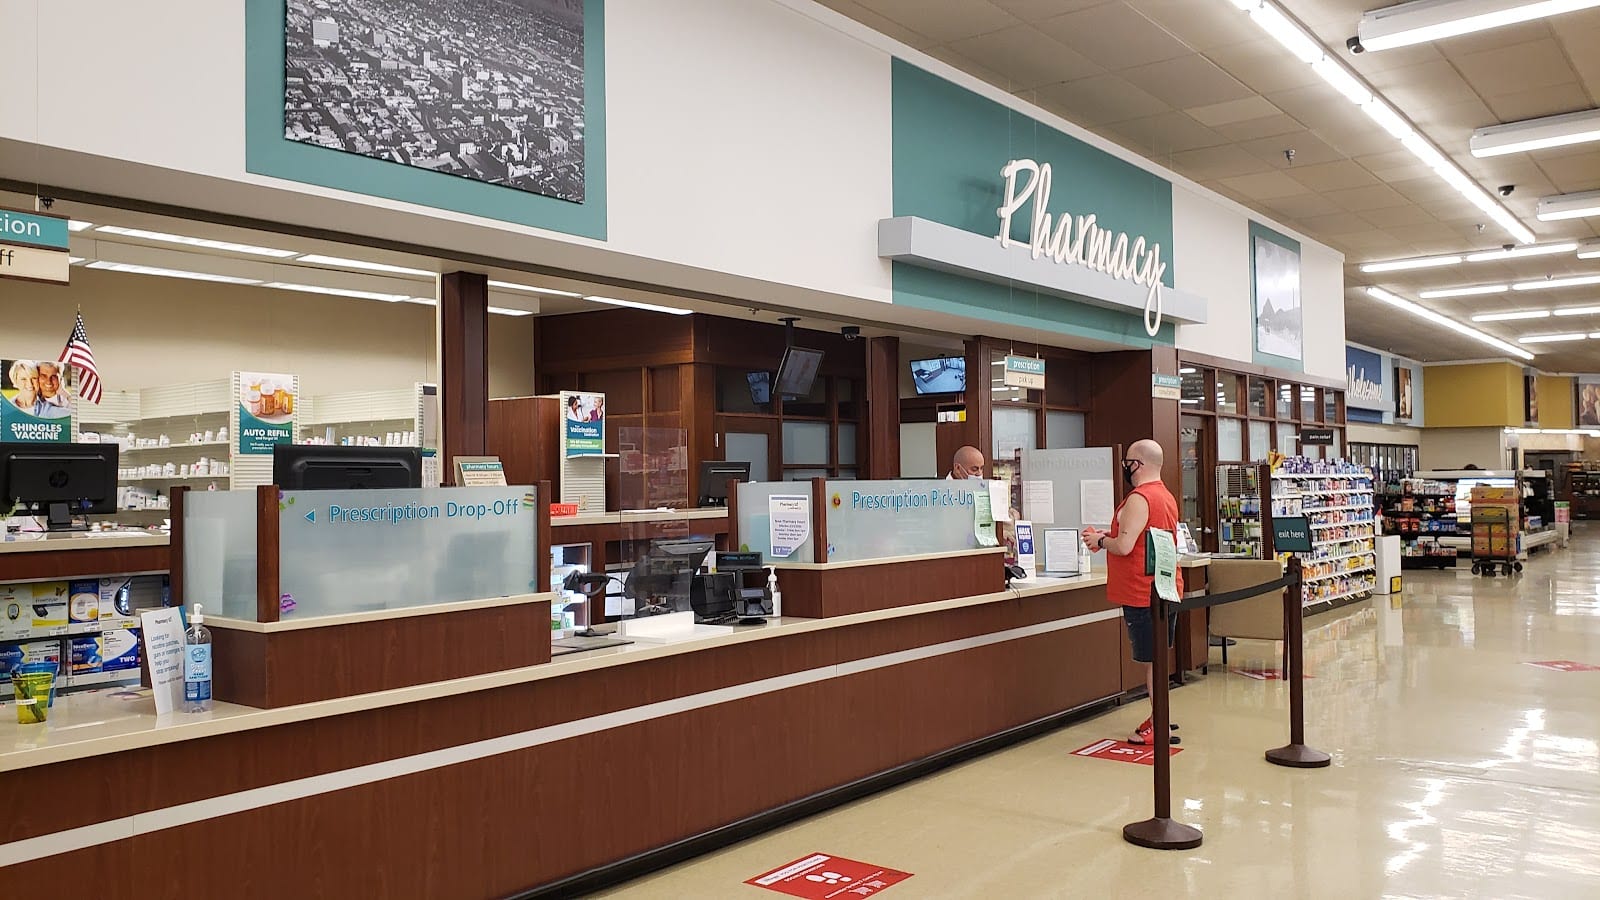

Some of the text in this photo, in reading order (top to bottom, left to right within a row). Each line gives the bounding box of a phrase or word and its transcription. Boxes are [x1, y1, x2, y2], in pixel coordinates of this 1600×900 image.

[997, 159, 1167, 337] Pharmacy
[1013, 359, 1041, 371] prescription
[10, 422, 63, 433] SHINGLES
[243, 428, 290, 438] AUTO REFILL
[14, 431, 60, 440] VACCINE
[852, 487, 975, 513] Prescription Pick-Up
[329, 497, 520, 525] Prescription Drop-Off
[1278, 529, 1306, 539] exit here
